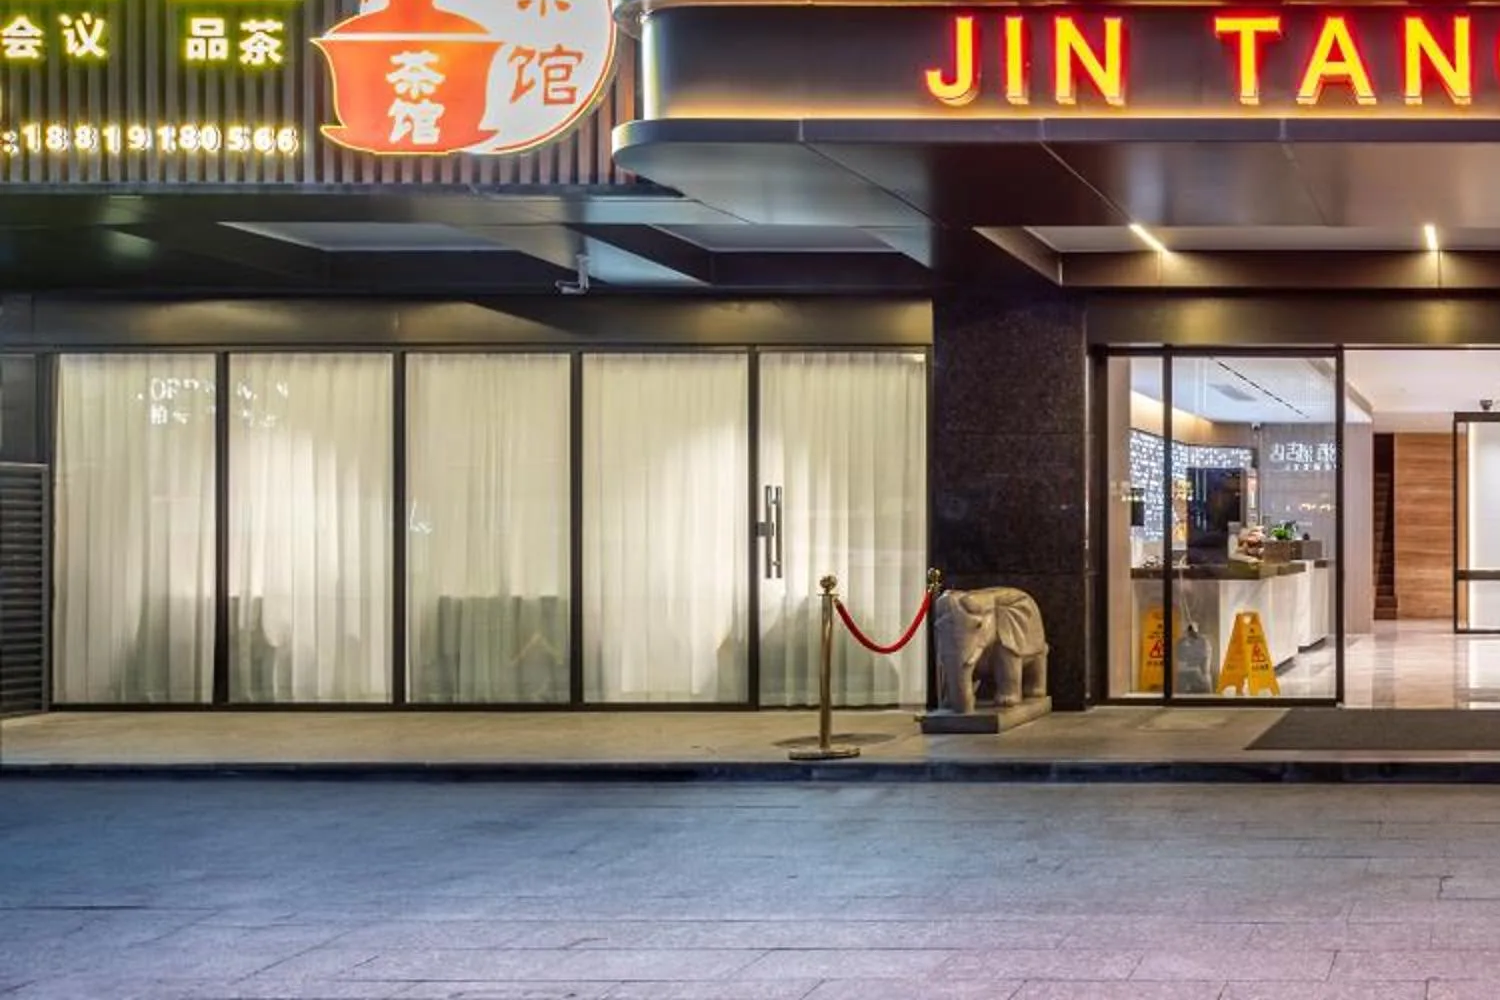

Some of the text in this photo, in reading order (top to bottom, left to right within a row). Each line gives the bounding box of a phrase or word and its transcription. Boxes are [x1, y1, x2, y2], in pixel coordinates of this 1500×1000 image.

[0, 12, 284, 65] 会议 品茶
[923, 14, 1126, 107] JIN
[385, 50, 446, 145] 茶馆
